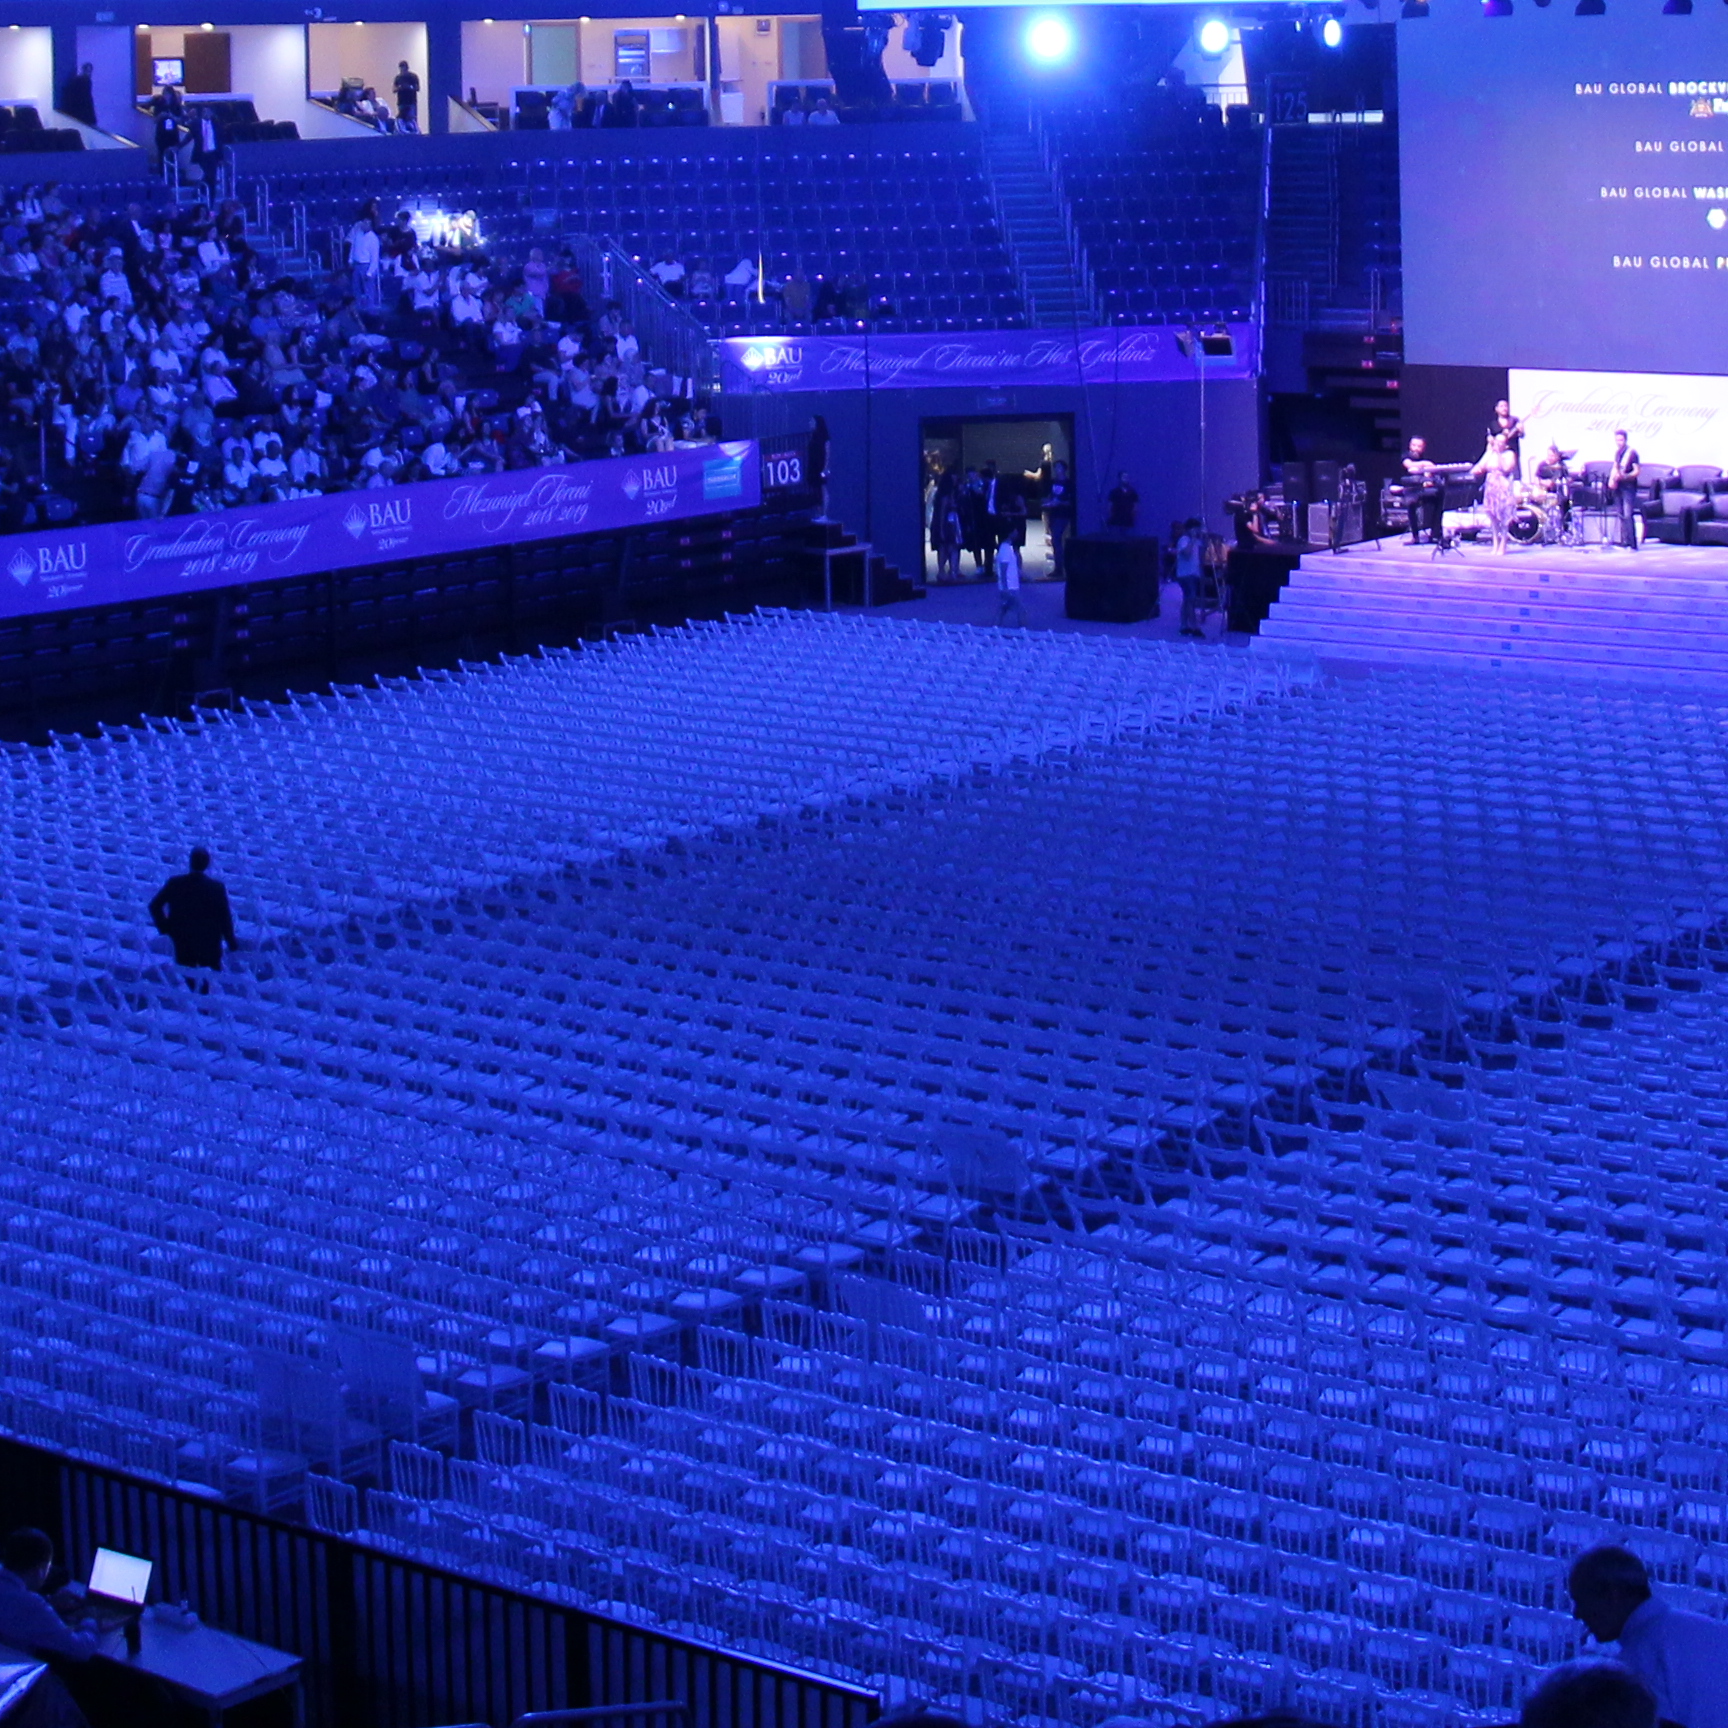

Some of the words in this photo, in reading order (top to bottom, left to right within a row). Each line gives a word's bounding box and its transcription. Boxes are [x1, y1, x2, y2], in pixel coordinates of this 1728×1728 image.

[1575, 82, 1604, 95] BAU
[1609, 81, 1663, 95] GLOBAL
[1274, 91, 1309, 121] 125
[1635, 140, 1663, 153] BAU
[1669, 140, 1724, 153] GLOBAL
[1600, 187, 1628, 199] BAU
[1634, 187, 1687, 199] GLOBAL
[1613, 256, 1642, 268] BAU
[1650, 256, 1709, 269] GLOBAL
[761, 346, 803, 365] BAU
[642, 465, 678, 491] BAU
[766, 458, 801, 486] 103
[369, 498, 412, 528] BAU
[38, 542, 87, 574] BAU
